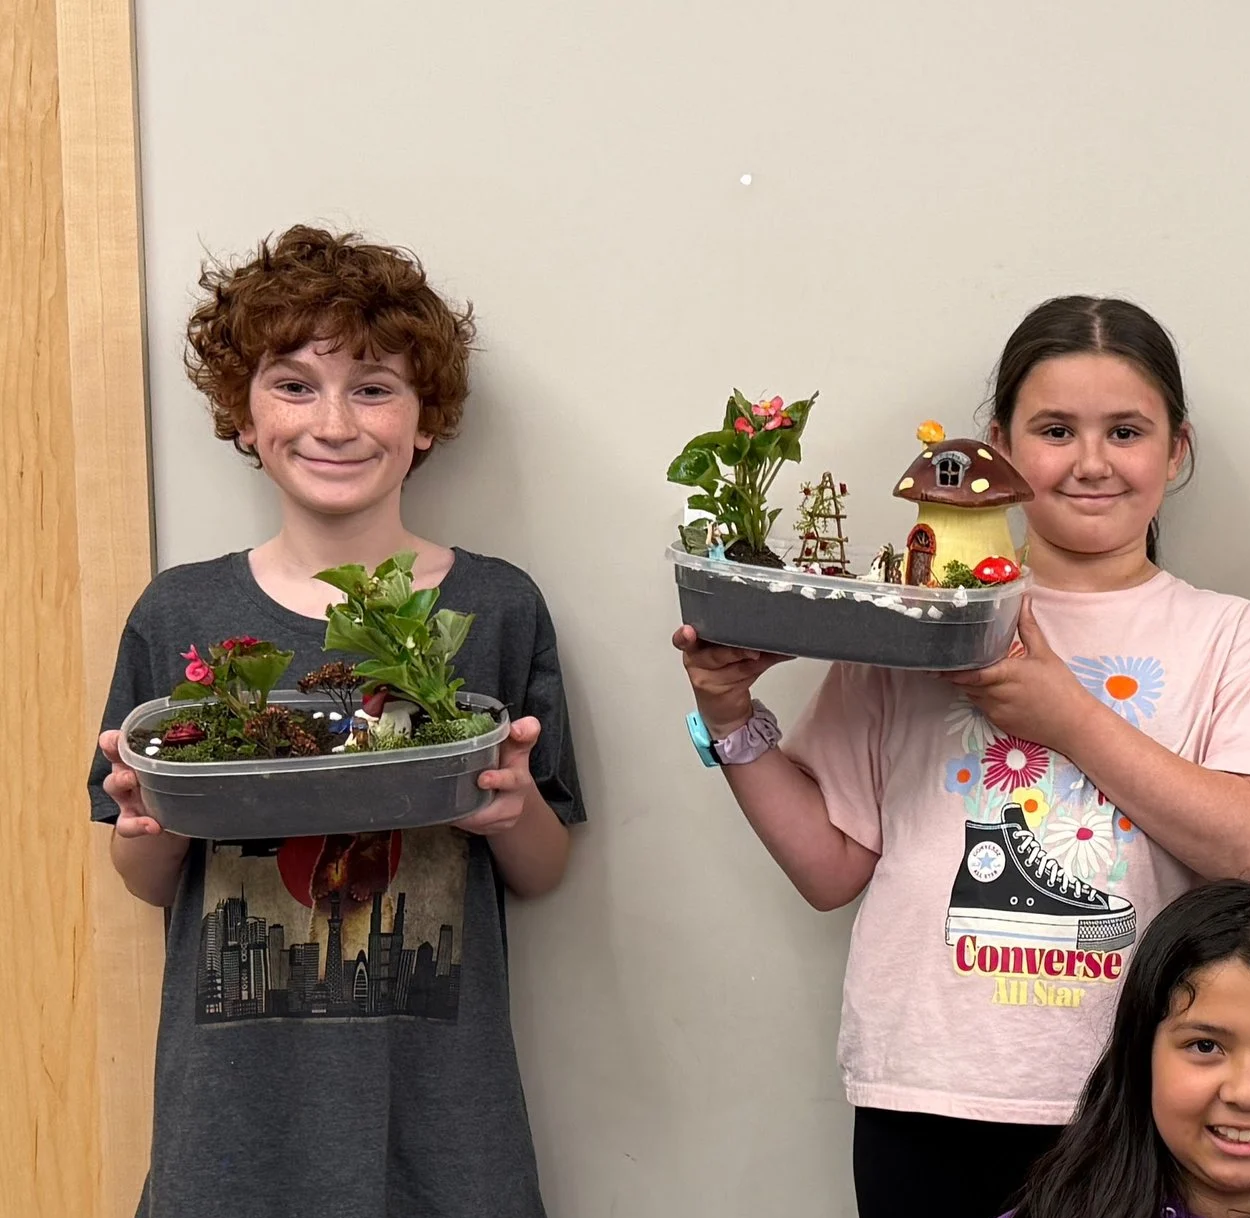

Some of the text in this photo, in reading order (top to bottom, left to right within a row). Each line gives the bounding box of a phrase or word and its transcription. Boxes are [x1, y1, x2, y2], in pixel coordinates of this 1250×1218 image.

[956, 934, 1122, 980] Converse
[992, 976, 1086, 1008] All Star
